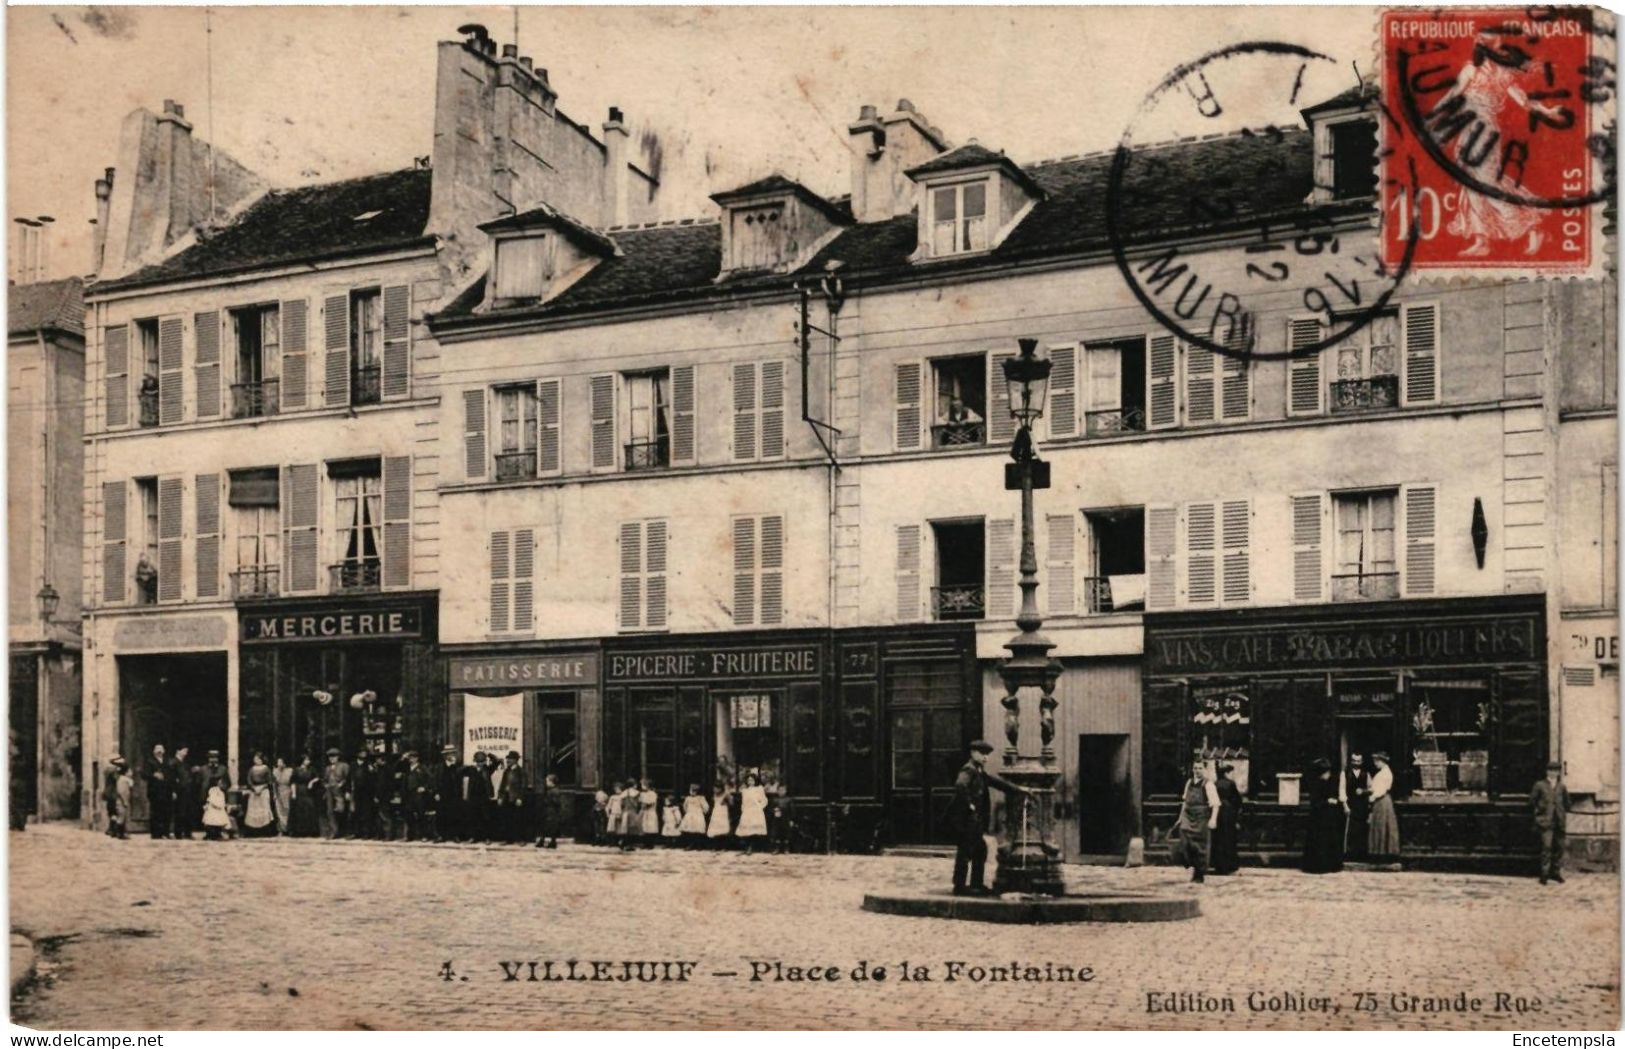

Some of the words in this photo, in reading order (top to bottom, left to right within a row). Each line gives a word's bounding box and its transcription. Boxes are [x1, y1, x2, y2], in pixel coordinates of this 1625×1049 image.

[1562, 167, 1582, 252] POSTES
[259, 612, 403, 638] MERCERIE
[462, 661, 584, 681] PATISSERIE
[612, 653, 696, 677] EPICERIE
[711, 650, 815, 675] FRUITERIE
[850, 653, 869, 667] 77
[468, 725, 519, 742] PATISSERIE
